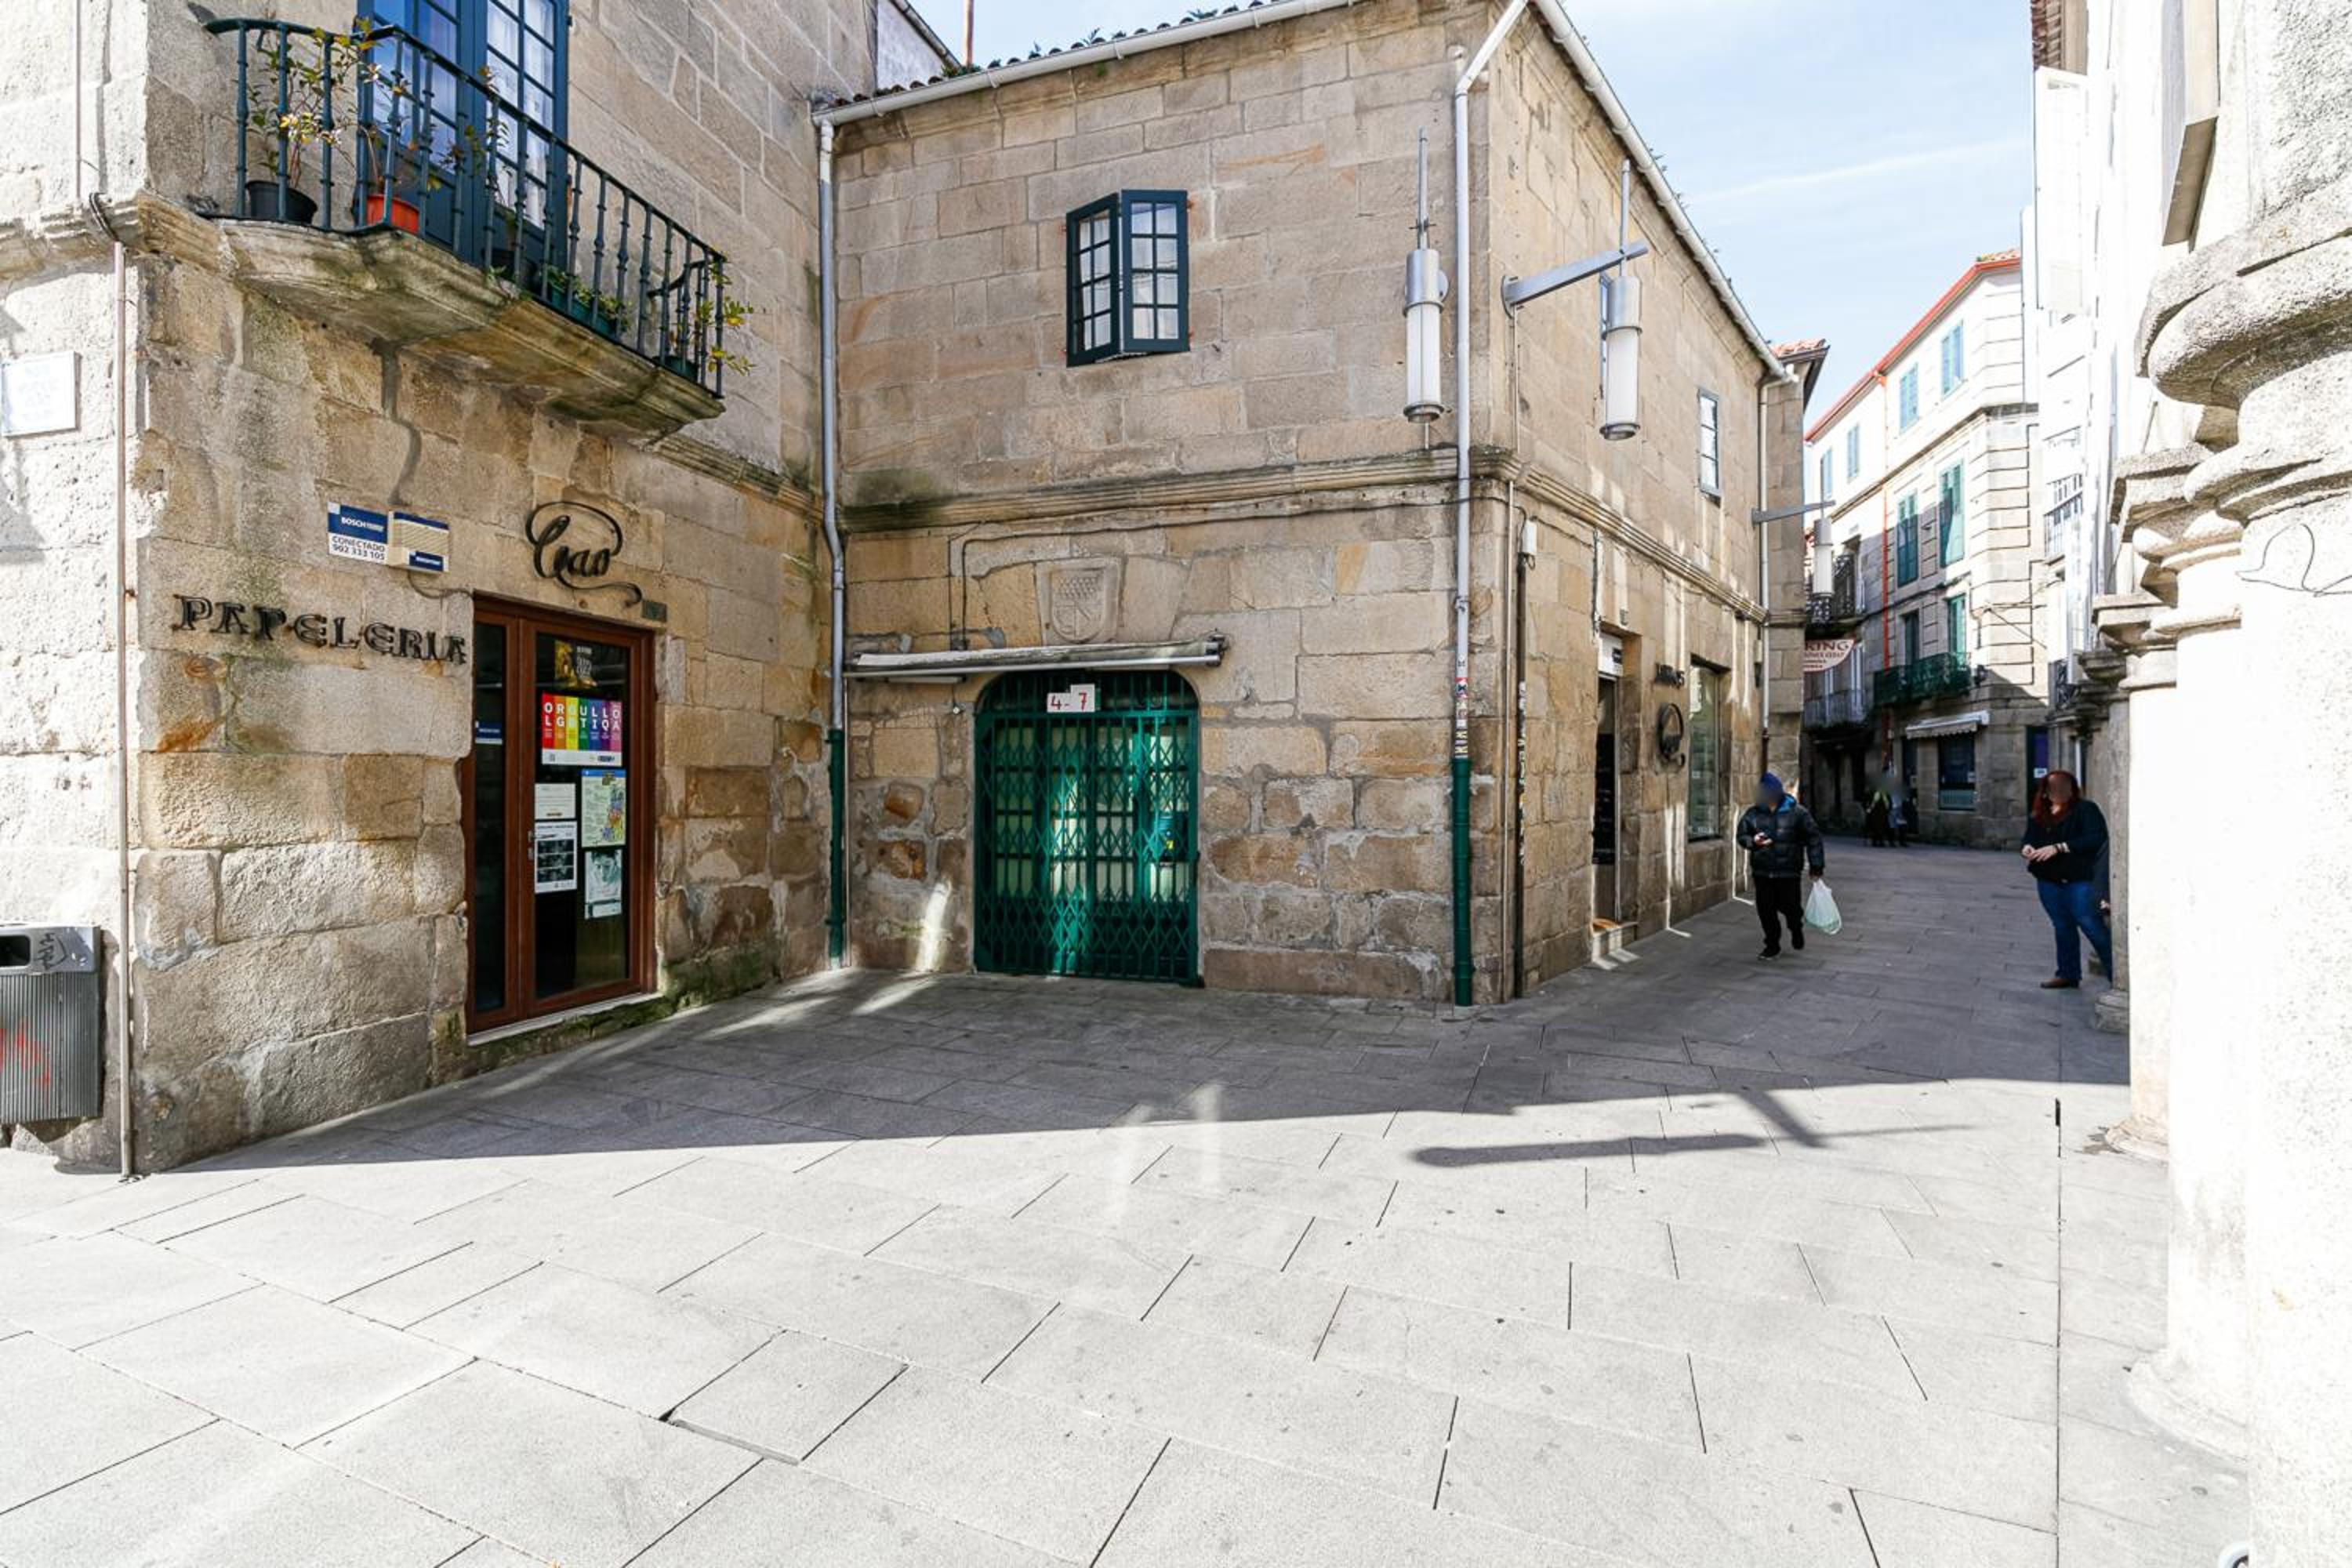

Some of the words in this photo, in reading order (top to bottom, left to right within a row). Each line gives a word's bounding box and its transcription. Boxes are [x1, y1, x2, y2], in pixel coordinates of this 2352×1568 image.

[341, 517, 366, 528] BOSCH
[332, 535, 385, 552] CONECTADO
[332, 543, 349, 553] 902
[351, 547, 368, 557] 333
[370, 551, 384, 561] 105
[172, 594, 466, 665] PAPELERIA
